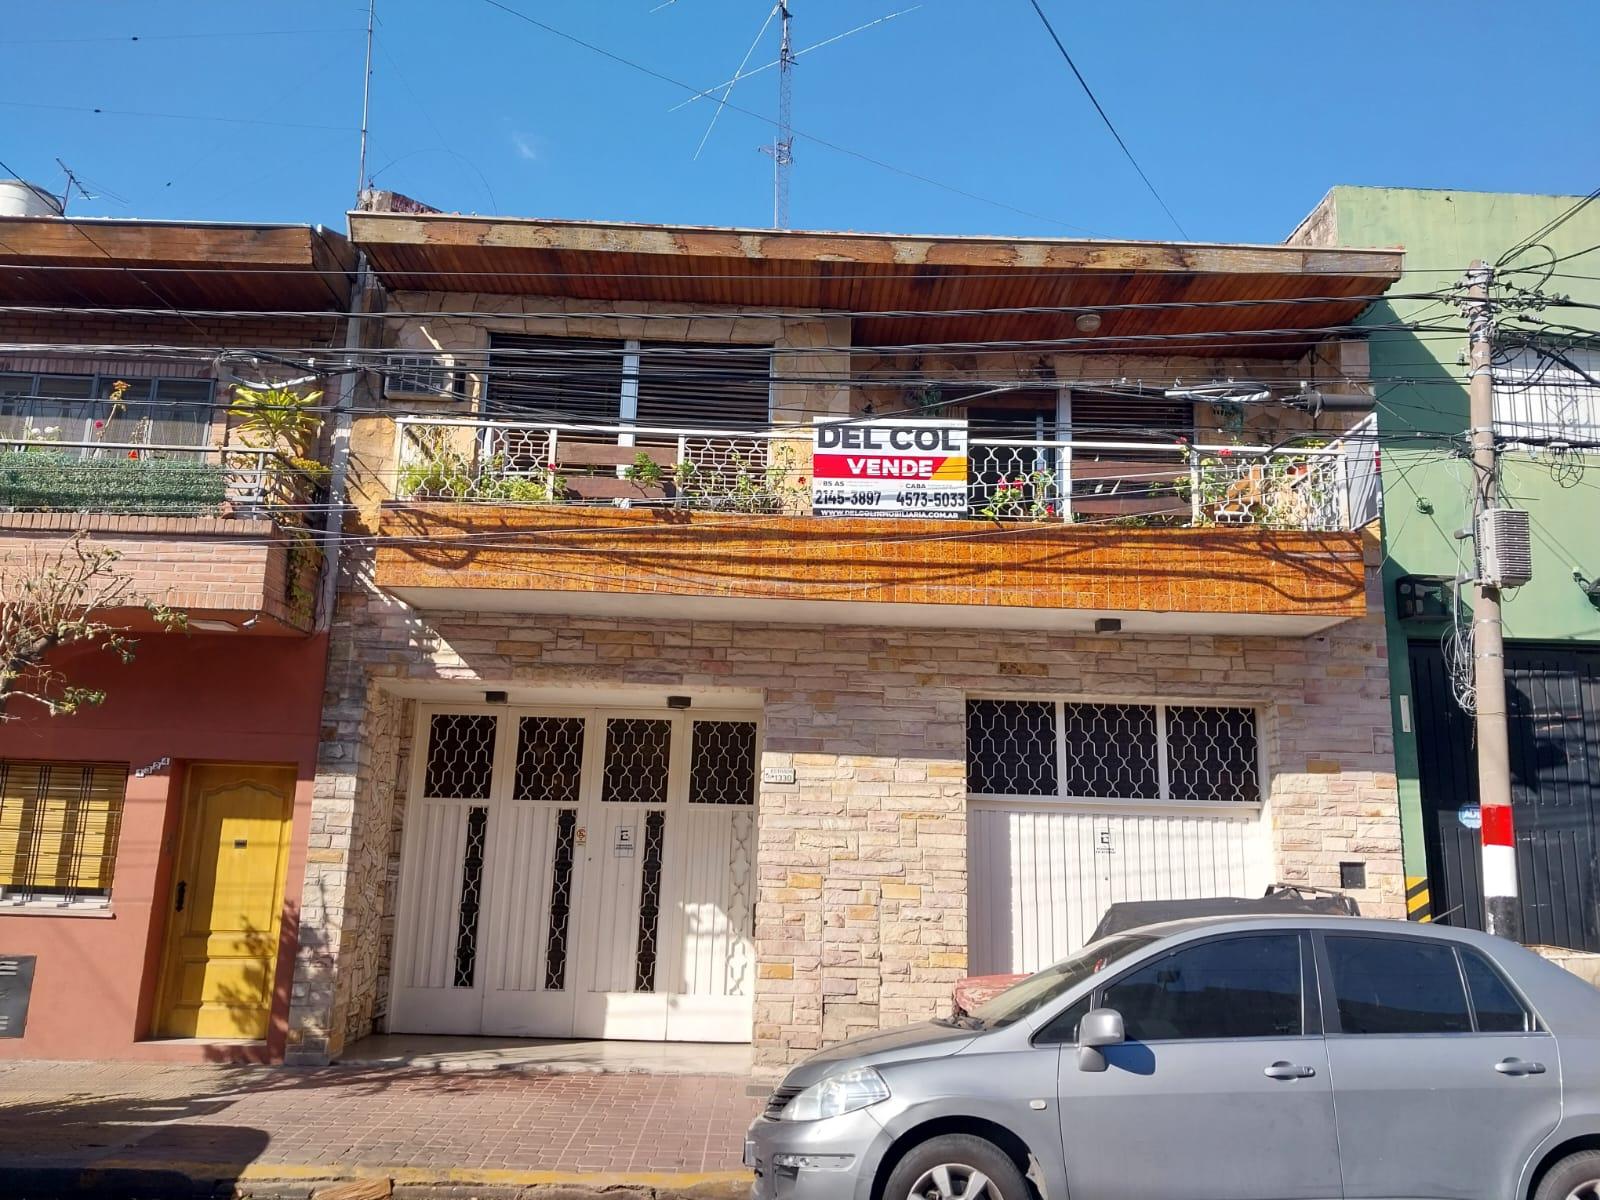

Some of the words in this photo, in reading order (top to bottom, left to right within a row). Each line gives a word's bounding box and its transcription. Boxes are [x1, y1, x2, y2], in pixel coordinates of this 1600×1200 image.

[817, 424, 883, 450] DEL
[889, 427, 961, 451] COL
[846, 458, 934, 477] VENDE
[815, 489, 881, 506] 2145-3897
[896, 491, 965, 507] 4573-5033
